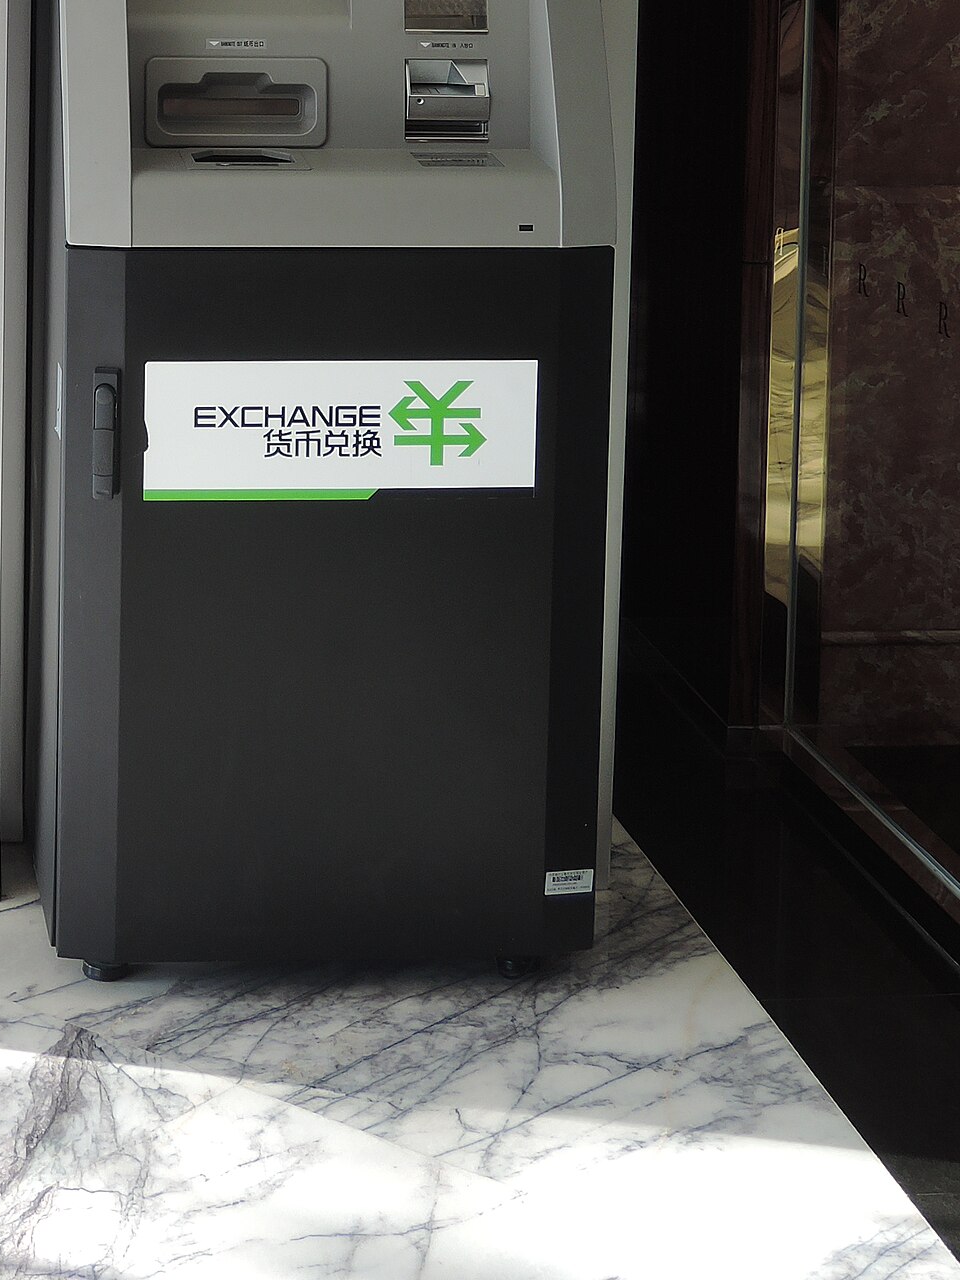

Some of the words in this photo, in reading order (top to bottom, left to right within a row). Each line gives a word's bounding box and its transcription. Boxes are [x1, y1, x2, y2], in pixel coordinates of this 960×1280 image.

[193, 405, 381, 428] EXCHANGE
[263, 429, 382, 458] 货币兑换
